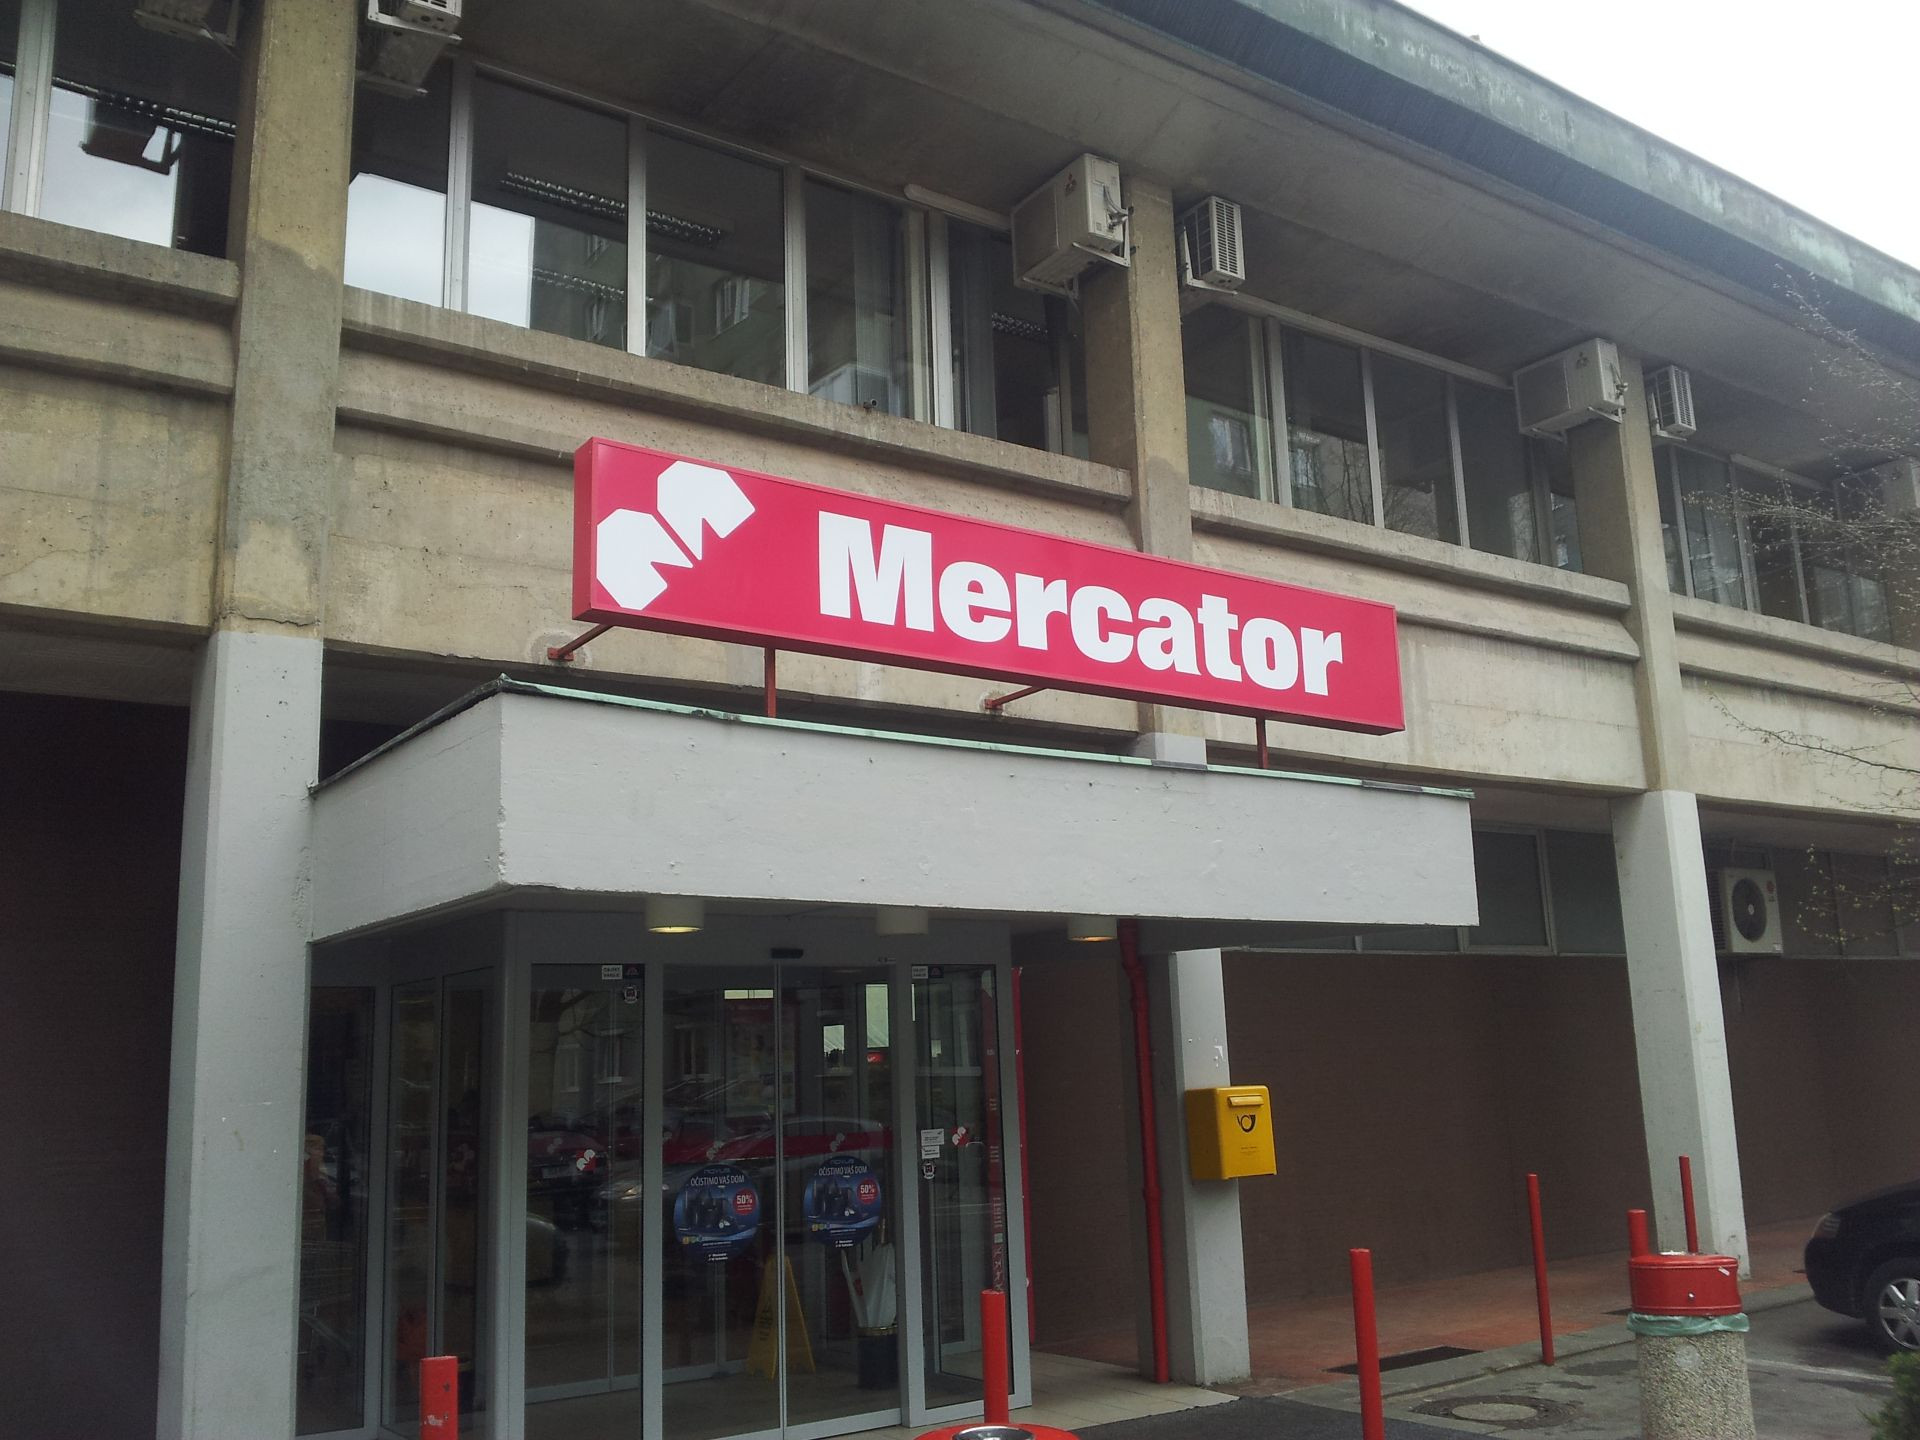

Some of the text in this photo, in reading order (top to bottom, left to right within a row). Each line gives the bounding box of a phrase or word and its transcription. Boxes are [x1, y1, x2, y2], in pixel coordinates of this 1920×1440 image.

[818, 510, 1344, 697] Mercator
[854, 1165, 868, 1174] DOM
[730, 1174, 745, 1183] DOM
[860, 1184, 875, 1194] 50%
[736, 1194, 753, 1204] 50%
